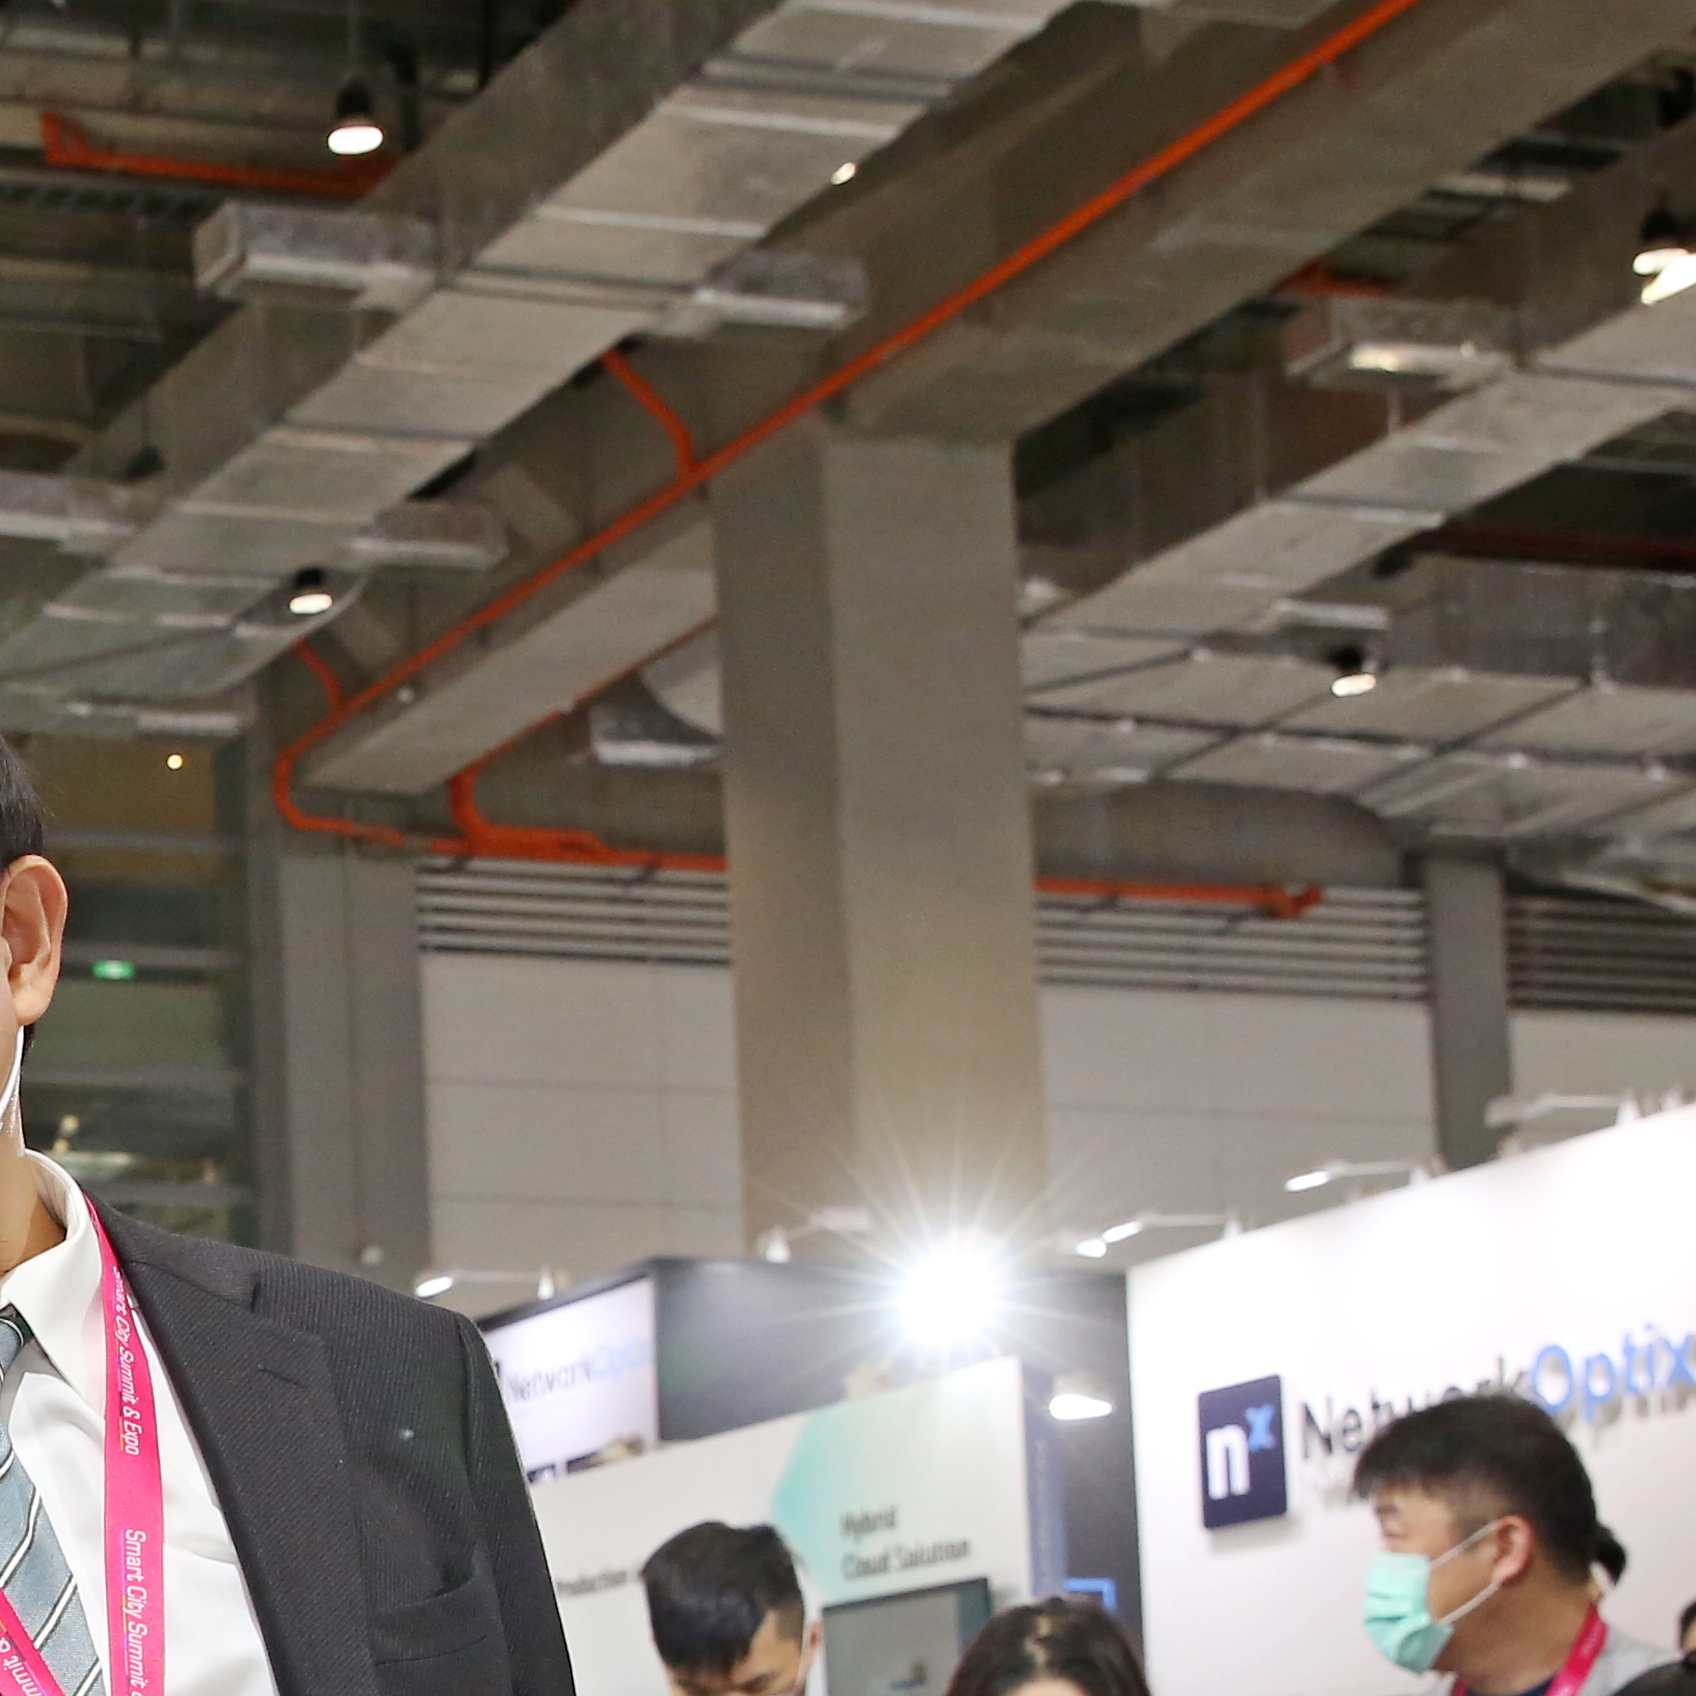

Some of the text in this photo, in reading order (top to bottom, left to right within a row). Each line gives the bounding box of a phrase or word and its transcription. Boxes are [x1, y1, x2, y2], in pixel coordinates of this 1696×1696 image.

[114, 1316, 131, 1348] City
[119, 1346, 140, 1406] Summit
[123, 1409, 140, 1420] &
[123, 1419, 142, 1456] Expo
[124, 1529, 147, 1582] Smart
[122, 1585, 148, 1623] City
[128, 1621, 149, 1689] Summit
